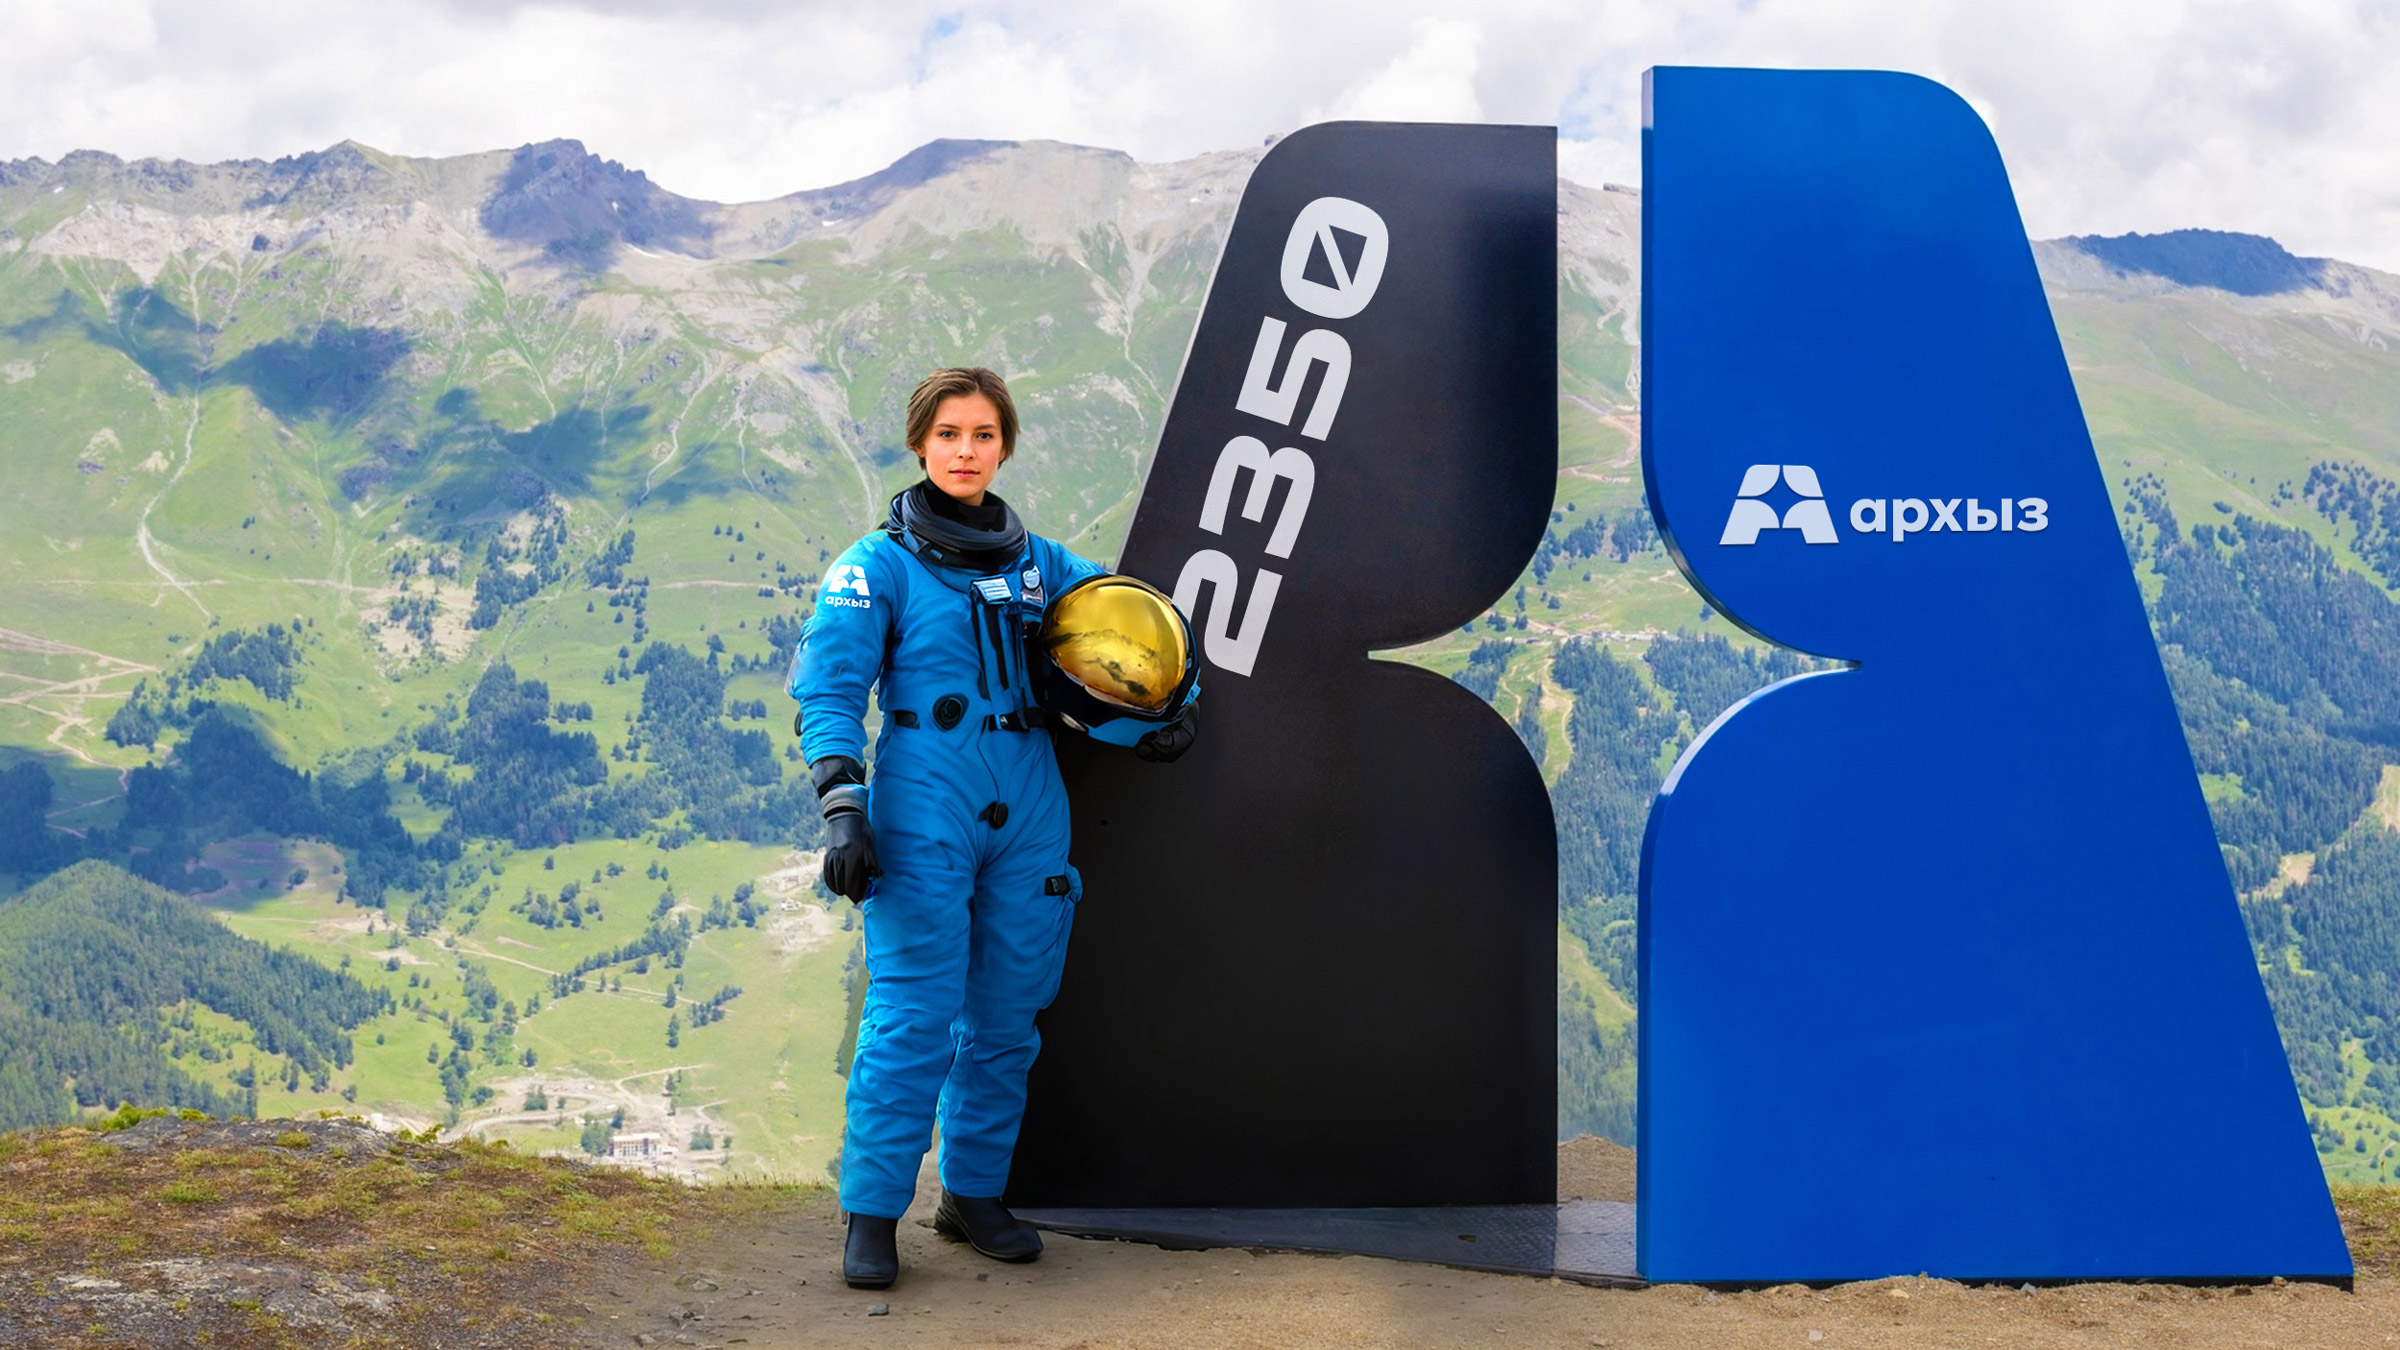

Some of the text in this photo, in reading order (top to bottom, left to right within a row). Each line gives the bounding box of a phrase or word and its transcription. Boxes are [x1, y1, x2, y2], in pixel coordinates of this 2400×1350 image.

[1172, 196, 1389, 677] 2350
[1849, 497, 2049, 542] архыз
[825, 595, 871, 609] архыз
